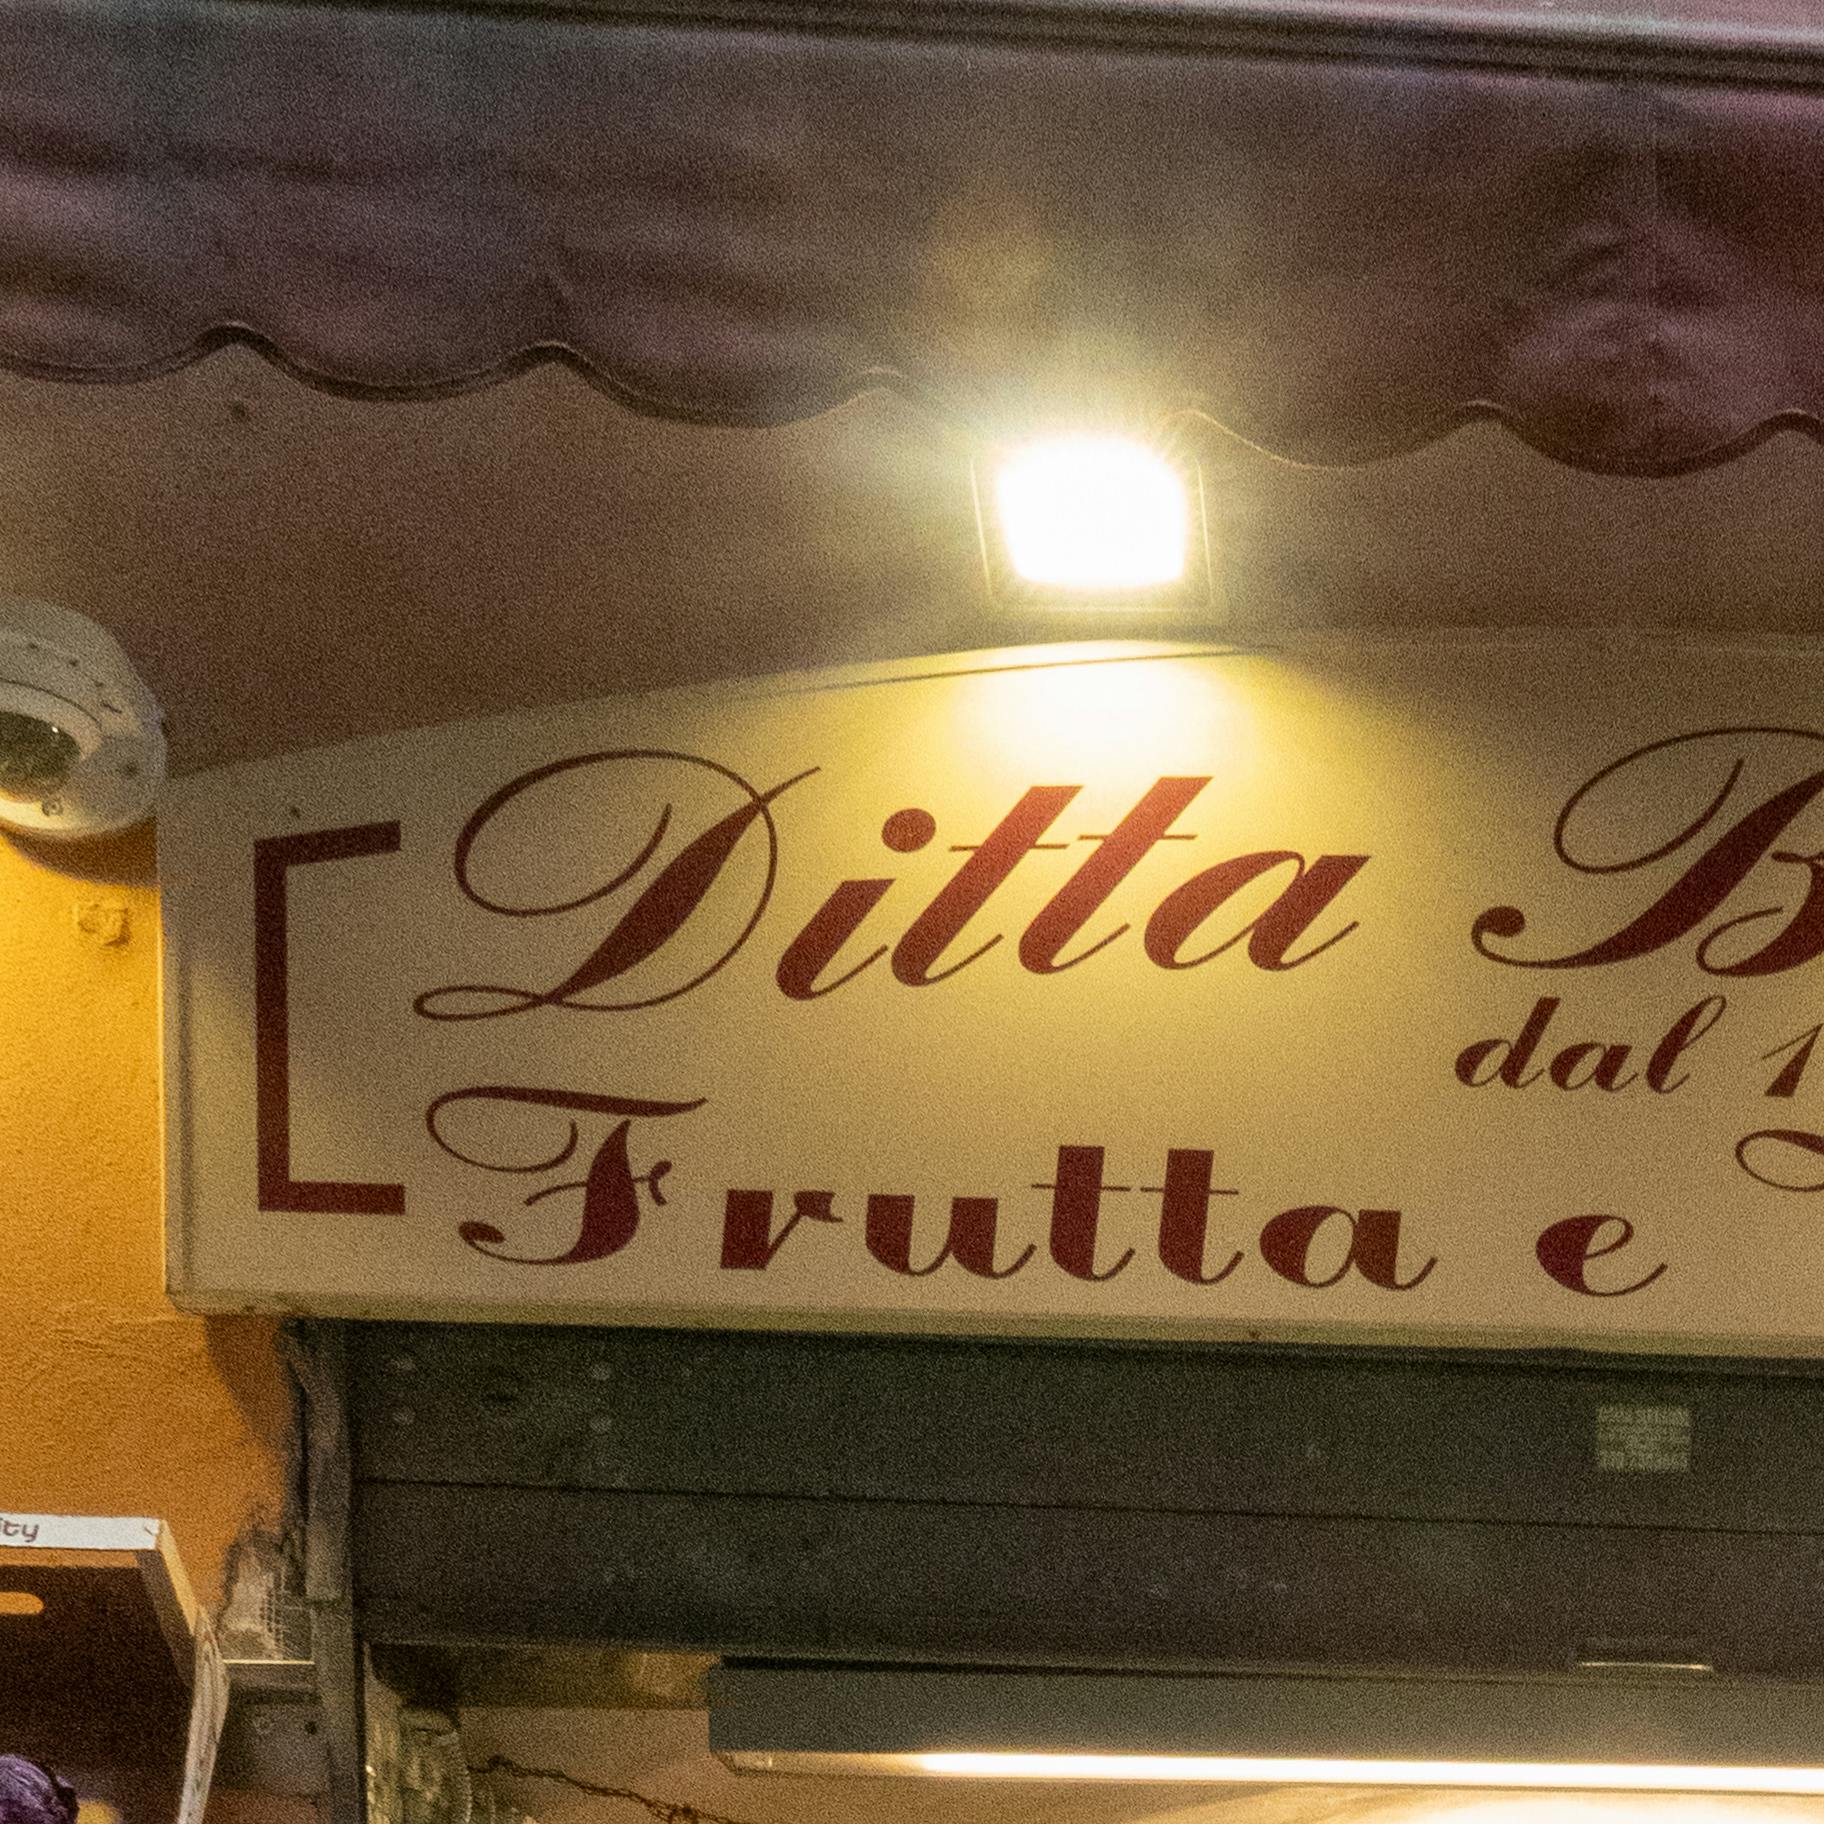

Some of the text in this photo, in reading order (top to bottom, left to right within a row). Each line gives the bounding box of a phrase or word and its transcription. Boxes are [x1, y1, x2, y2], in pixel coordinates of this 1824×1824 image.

[413, 751, 1371, 1021] Ditta
[1455, 995, 1727, 1095] dal
[427, 1086, 1437, 1292] Frutta
[1534, 1213, 1668, 1299] e
